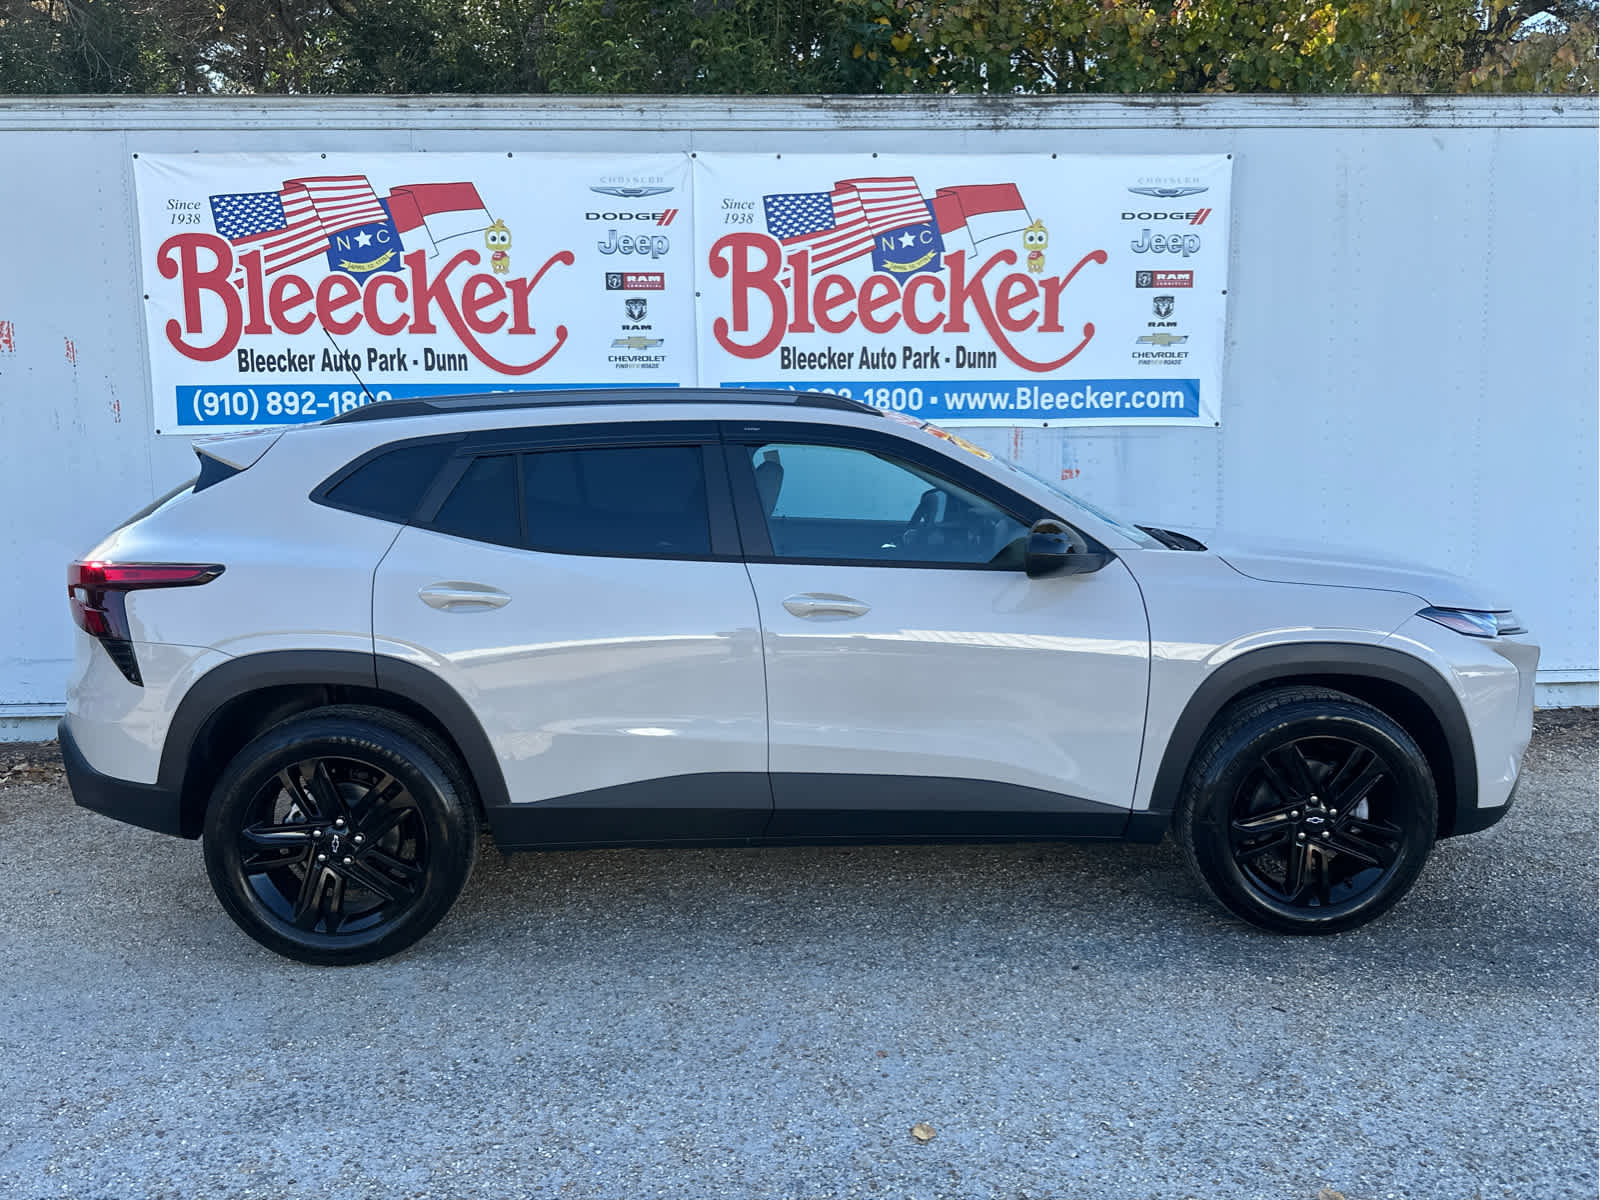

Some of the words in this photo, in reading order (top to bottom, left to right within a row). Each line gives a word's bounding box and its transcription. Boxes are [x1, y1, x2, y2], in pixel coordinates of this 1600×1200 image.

[167, 199, 201, 210] Since
[721, 198, 755, 210] Since
[171, 213, 201, 225] 1938
[585, 212, 665, 221] DODGE
[724, 212, 754, 224] 1938
[1121, 212, 1198, 220] DODGE
[336, 235, 351, 252] N
[376, 229, 391, 244] C
[597, 229, 670, 259] Jeep
[881, 236, 895, 252] N
[920, 230, 933, 244] C
[1130, 228, 1201, 257] Jeep
[237, 348, 315, 373] Bleecker
[321, 348, 362, 372] Auto
[367, 347, 408, 371] Park
[423, 347, 468, 372] Dunn
[780, 346, 854, 370] Bleecker
[858, 346, 897, 370] Auto
[902, 346, 940, 370] Park
[955, 345, 997, 369] Dunn
[1131, 351, 1189, 359] CHEVROLET
[192, 388, 259, 421] (910)
[944, 385, 1185, 410] www.Bleecker.com
